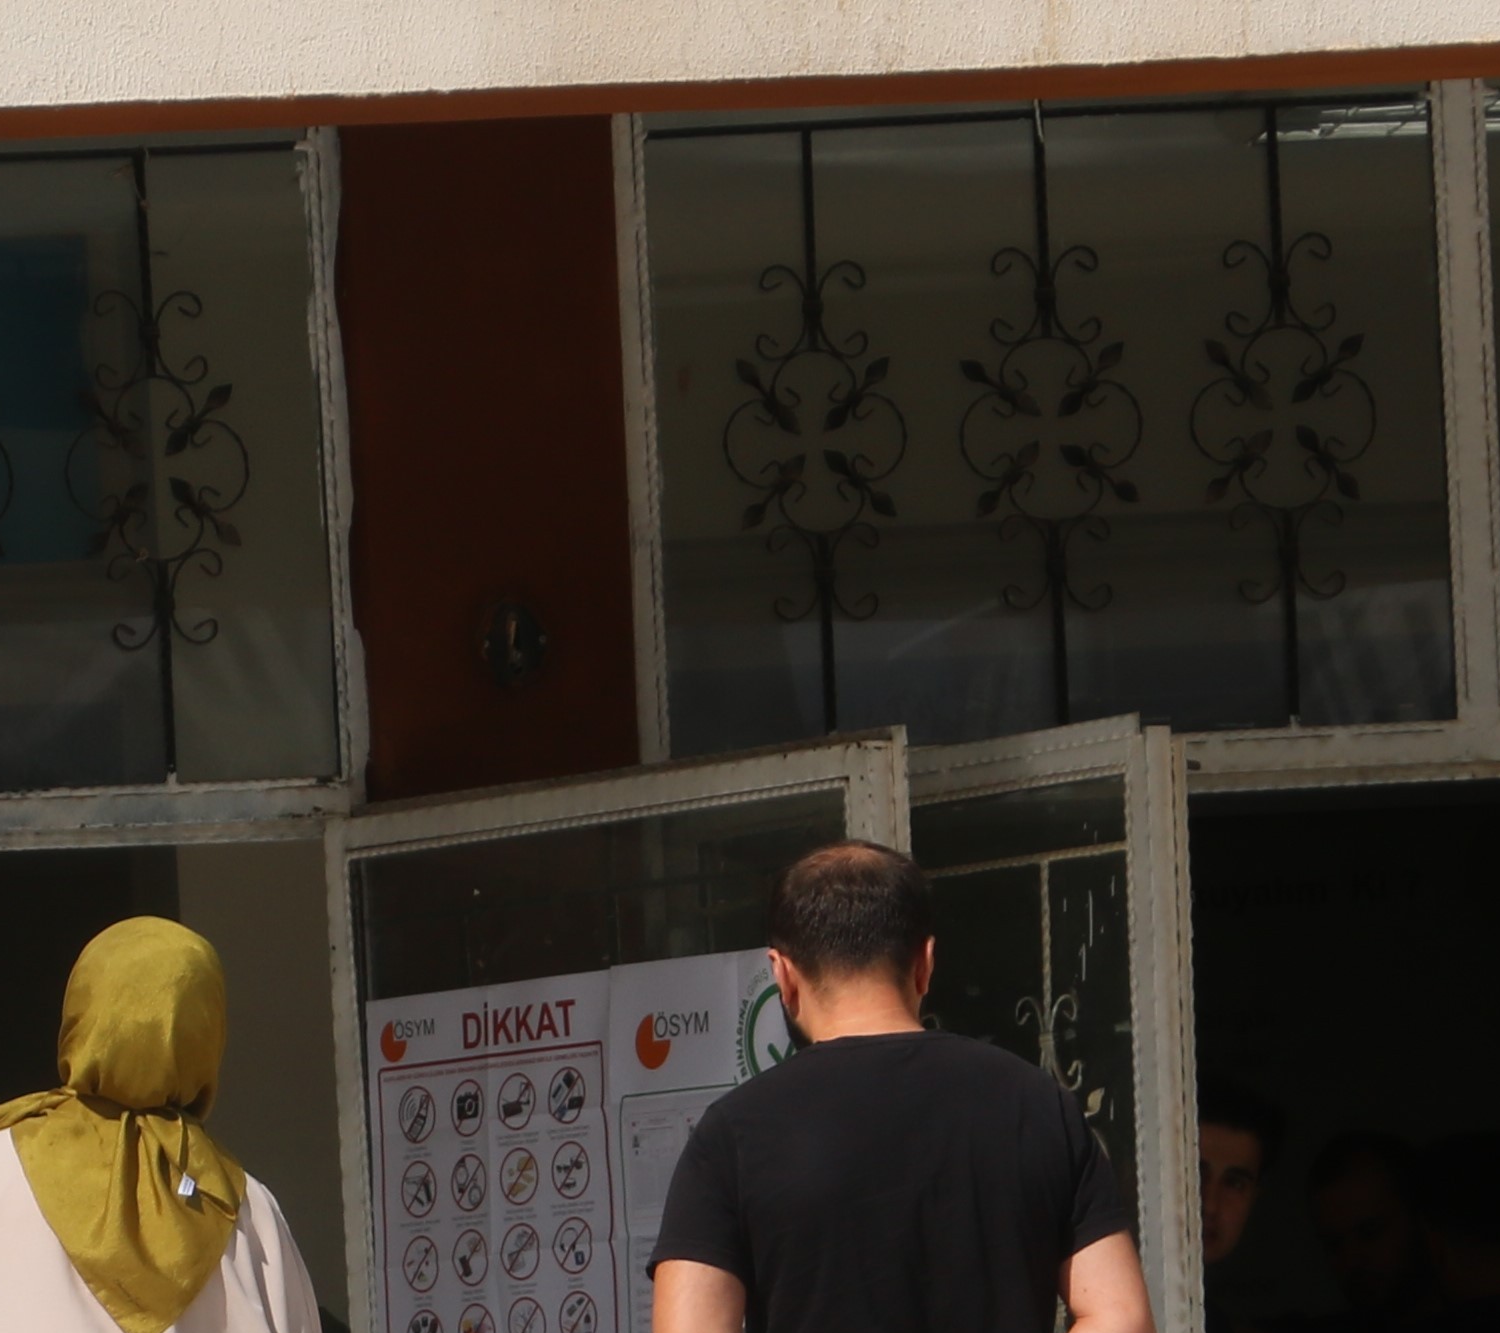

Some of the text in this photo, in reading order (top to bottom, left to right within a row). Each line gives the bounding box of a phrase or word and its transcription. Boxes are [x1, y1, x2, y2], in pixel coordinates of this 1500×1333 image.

[393, 1018, 435, 1040] ÖSYM
[462, 999, 576, 1050] DİKKAT
[653, 1010, 709, 1038] ÖSYM
